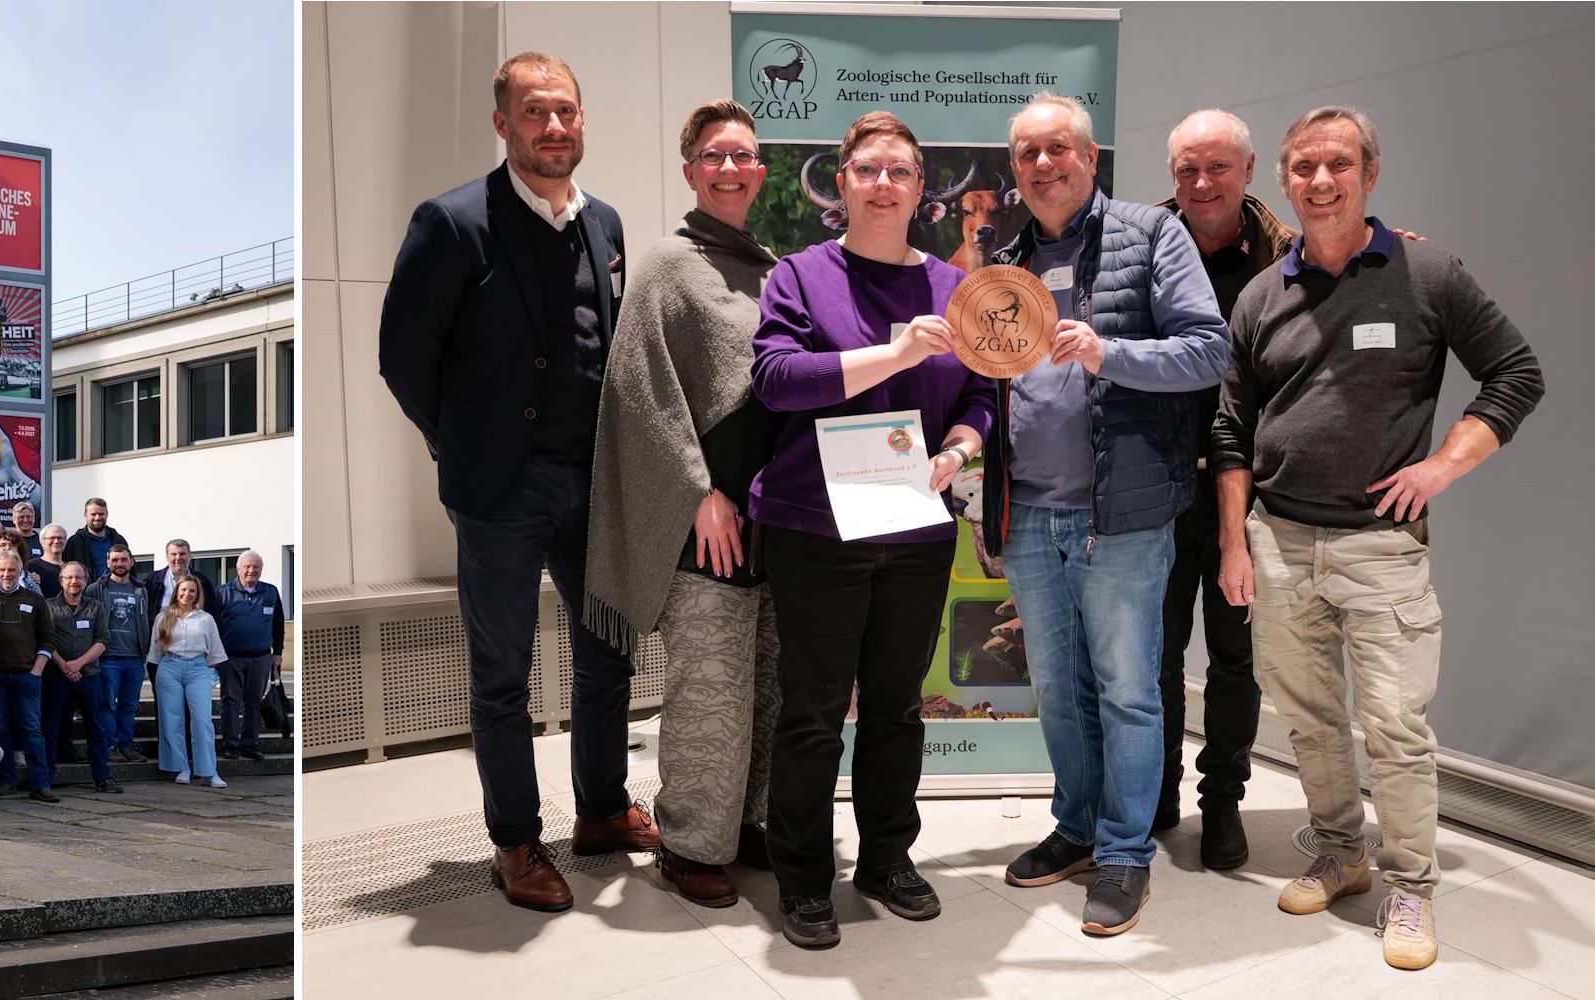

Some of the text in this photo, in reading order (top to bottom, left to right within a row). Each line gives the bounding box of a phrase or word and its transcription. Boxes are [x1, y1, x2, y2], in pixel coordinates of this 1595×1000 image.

[836, 69, 1058, 86] Zoologische Gesellschaft für
[836, 88, 884, 102] Arten-
[890, 90, 919, 103] und
[924, 90, 1069, 106] Populationssc
[750, 101, 818, 120] ZGAP
[952, 269, 1028, 307] Premiumpartner
[1028, 279, 1052, 312] Bronze
[974, 336, 1028, 353] ZGAP
[958, 346, 1044, 375] für den Artenschutz
[923, 739, 977, 756] gap.de
